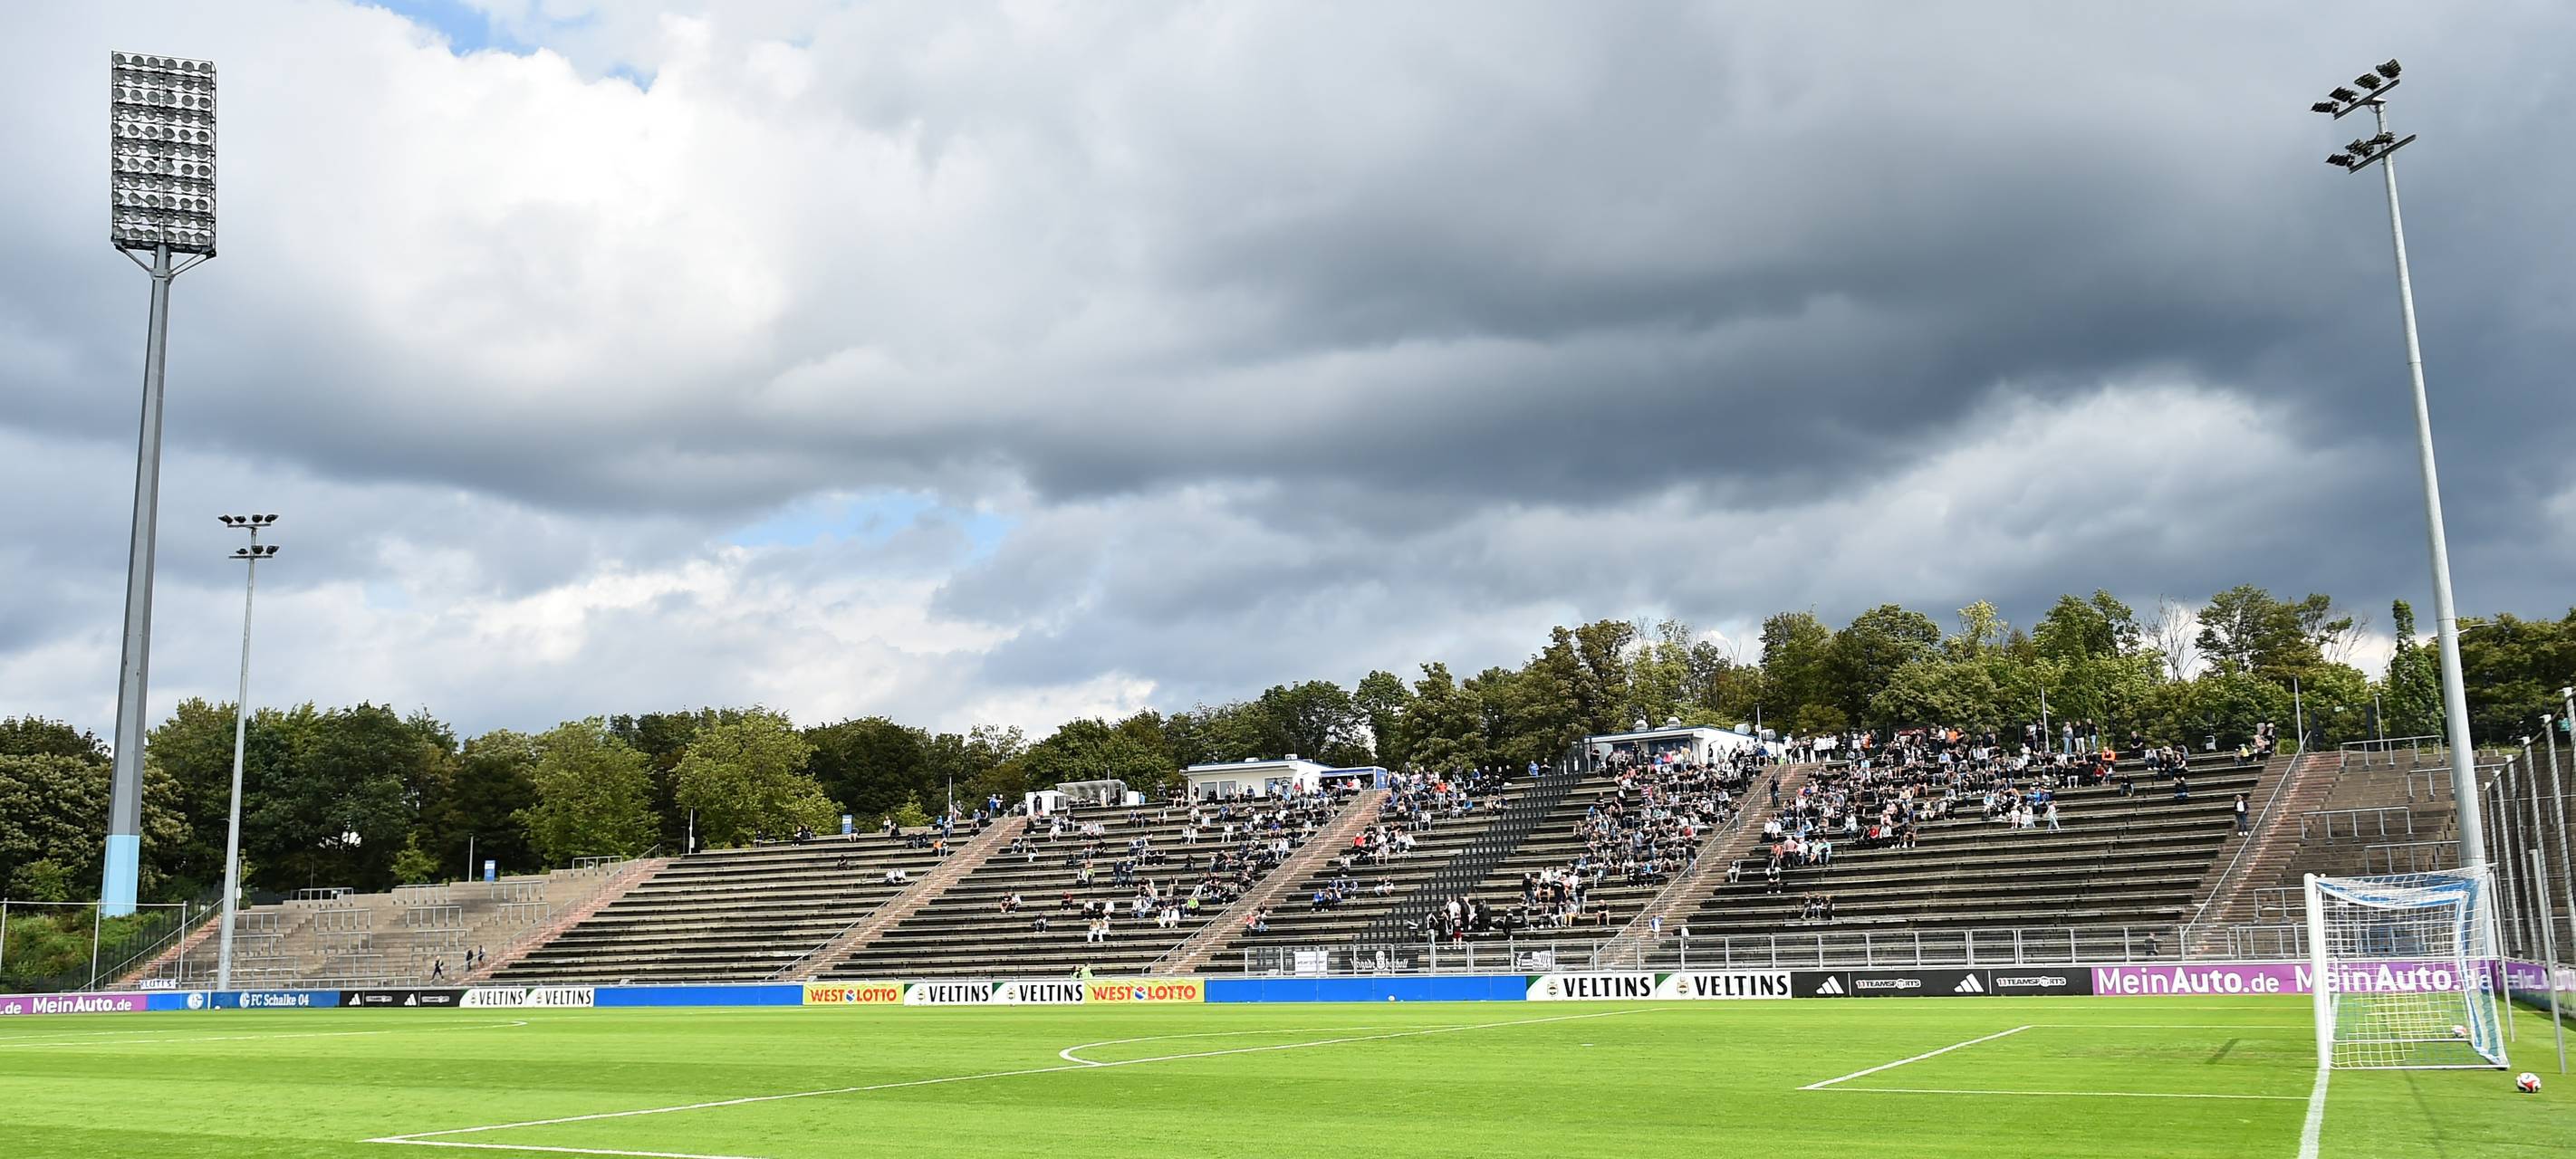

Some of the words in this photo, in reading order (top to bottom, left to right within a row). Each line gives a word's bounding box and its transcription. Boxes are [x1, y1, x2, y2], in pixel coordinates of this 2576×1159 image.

[1563, 977, 1651, 998] VELTINS
[1694, 975, 1788, 996] VELTINS
[2098, 966, 2280, 994] MeinAuto.de
[251, 993, 263, 1006] FC
[264, 993, 296, 1006] Schalke
[298, 993, 310, 1006] 04
[479, 991, 524, 1006] VELTINS
[545, 990, 591, 1005] VELTINS
[811, 989, 845, 1002] WEST
[856, 988, 898, 1001] LOTTO
[928, 985, 989, 1002] VELTINS
[1019, 984, 1083, 1001] VELTINS
[1092, 986, 1132, 1001] WEST
[1147, 985, 1197, 1001] LOTTO
[32, 996, 132, 1014] MeinAuto.de
